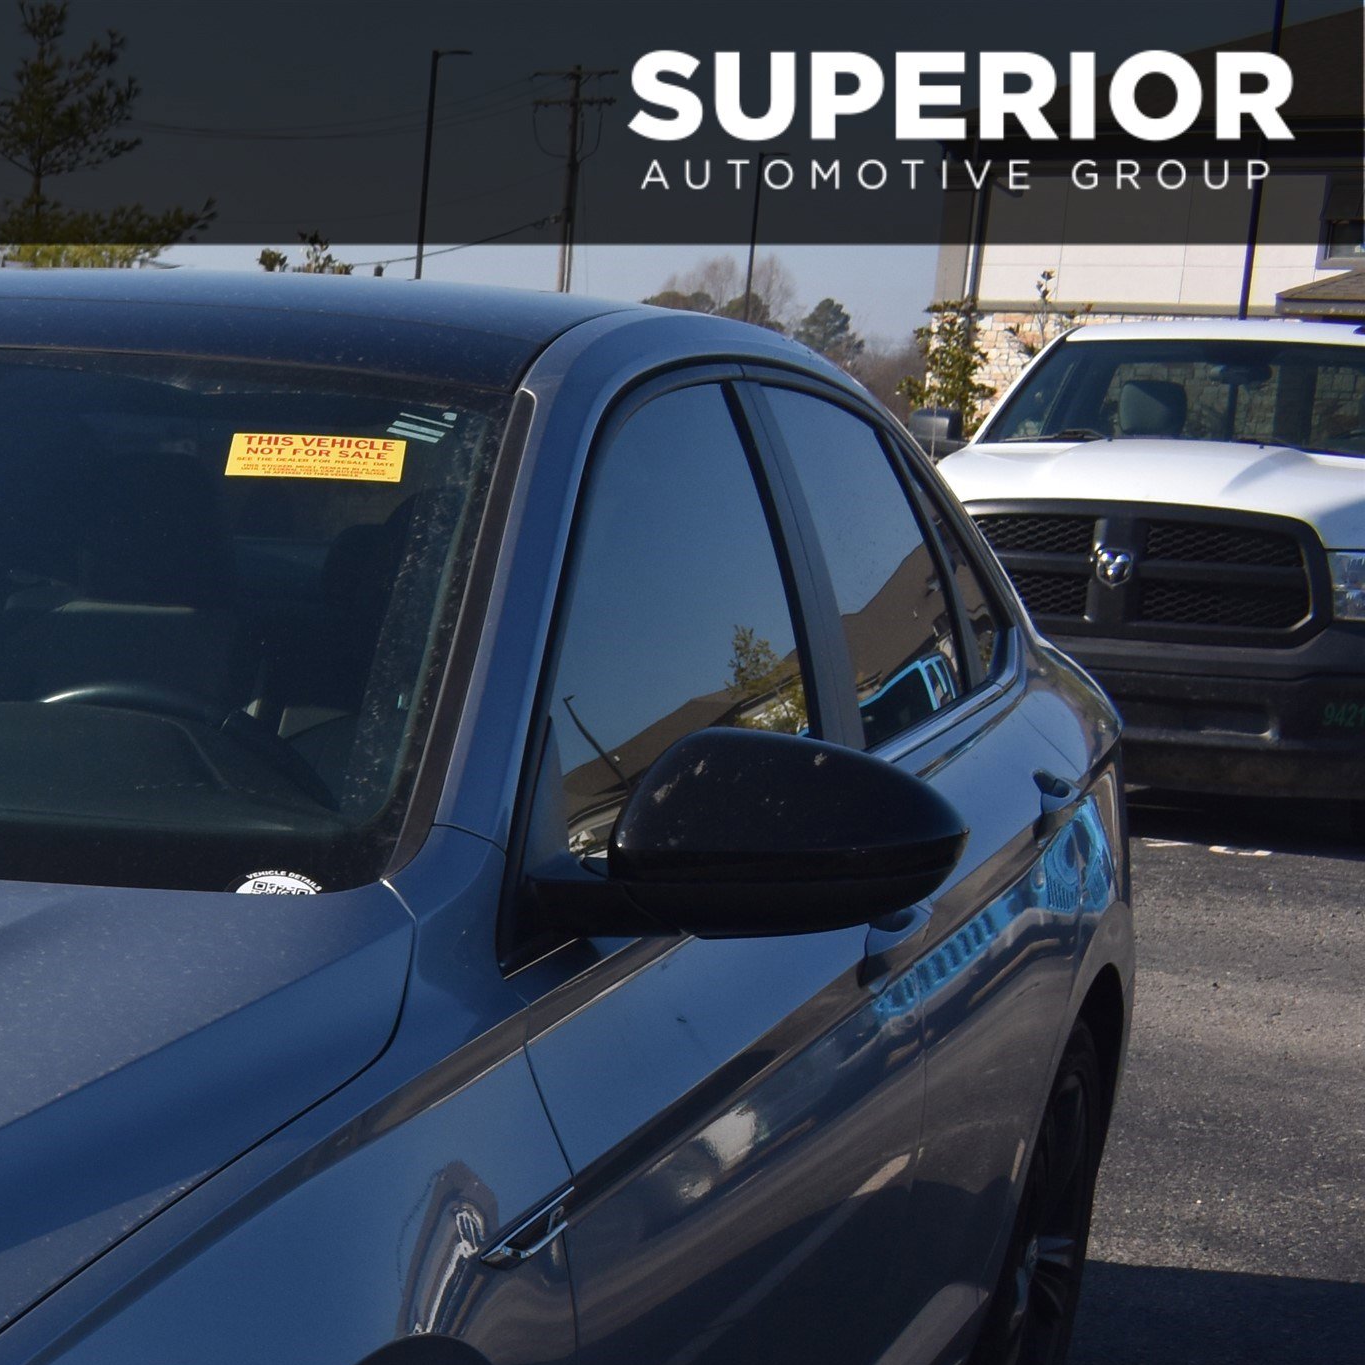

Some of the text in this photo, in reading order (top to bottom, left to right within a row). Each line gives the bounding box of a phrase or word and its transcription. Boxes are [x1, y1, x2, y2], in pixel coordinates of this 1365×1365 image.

[244, 435, 395, 451] THIS VEHICLE
[246, 447, 388, 460] NOT FOR SALE
[245, 870, 323, 892] VEHICLE DETAILS
